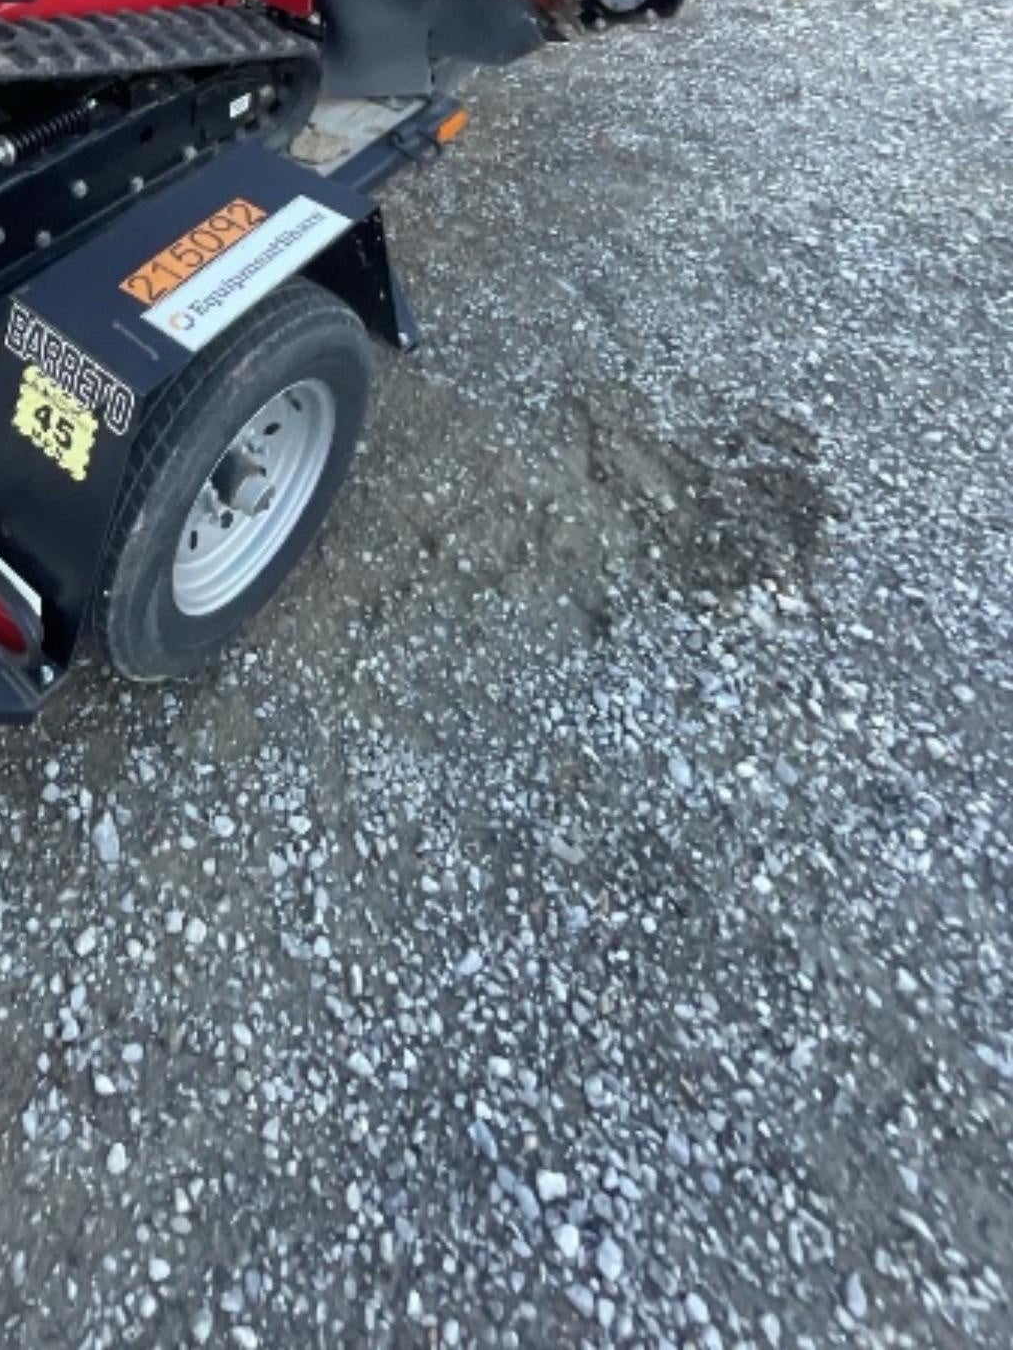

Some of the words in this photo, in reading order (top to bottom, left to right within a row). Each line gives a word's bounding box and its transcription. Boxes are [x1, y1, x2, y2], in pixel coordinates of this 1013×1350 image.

[128, 203, 266, 300] 215092
[189, 211, 326, 316] EquipmentShare
[4, 302, 135, 436] BARRETO
[34, 405, 75, 448] 45
